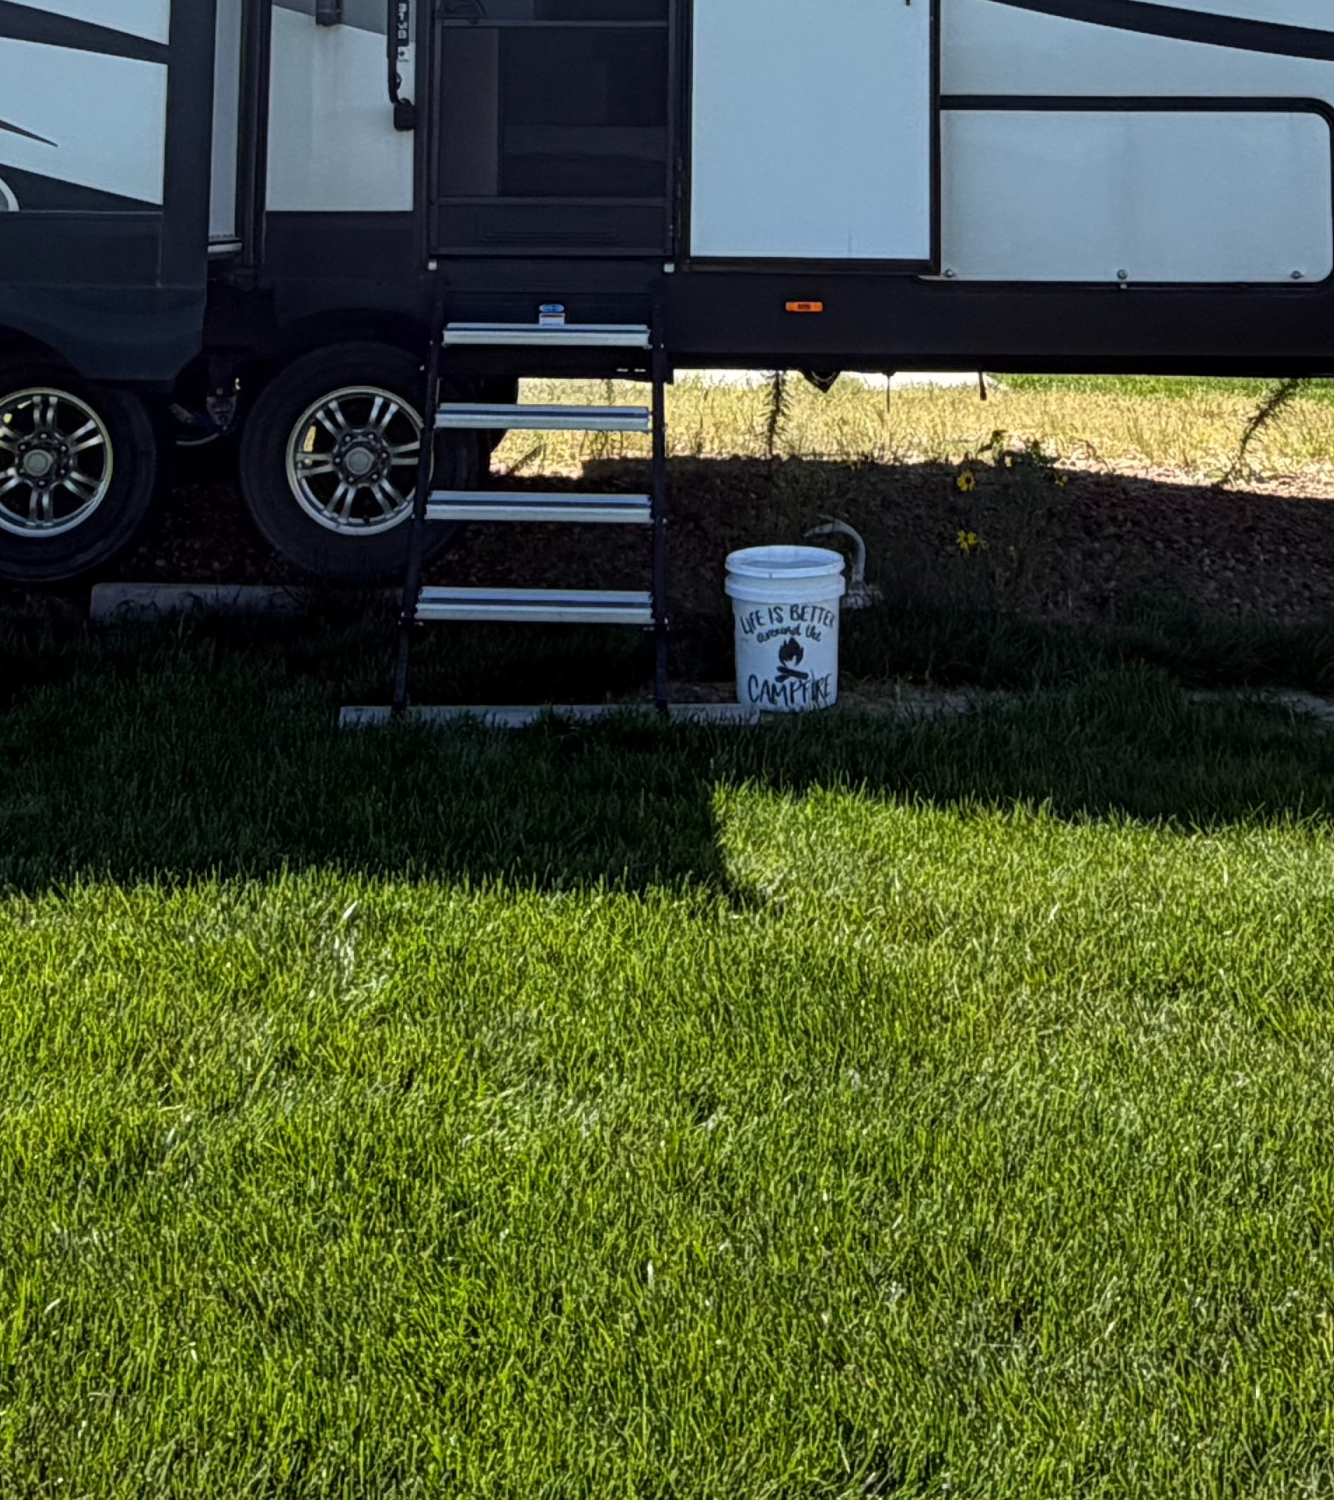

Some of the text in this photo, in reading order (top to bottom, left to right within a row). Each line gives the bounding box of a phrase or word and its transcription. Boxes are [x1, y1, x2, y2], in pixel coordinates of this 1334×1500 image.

[740, 604, 835, 634] LIFE IS BETTER
[757, 623, 801, 643] around
